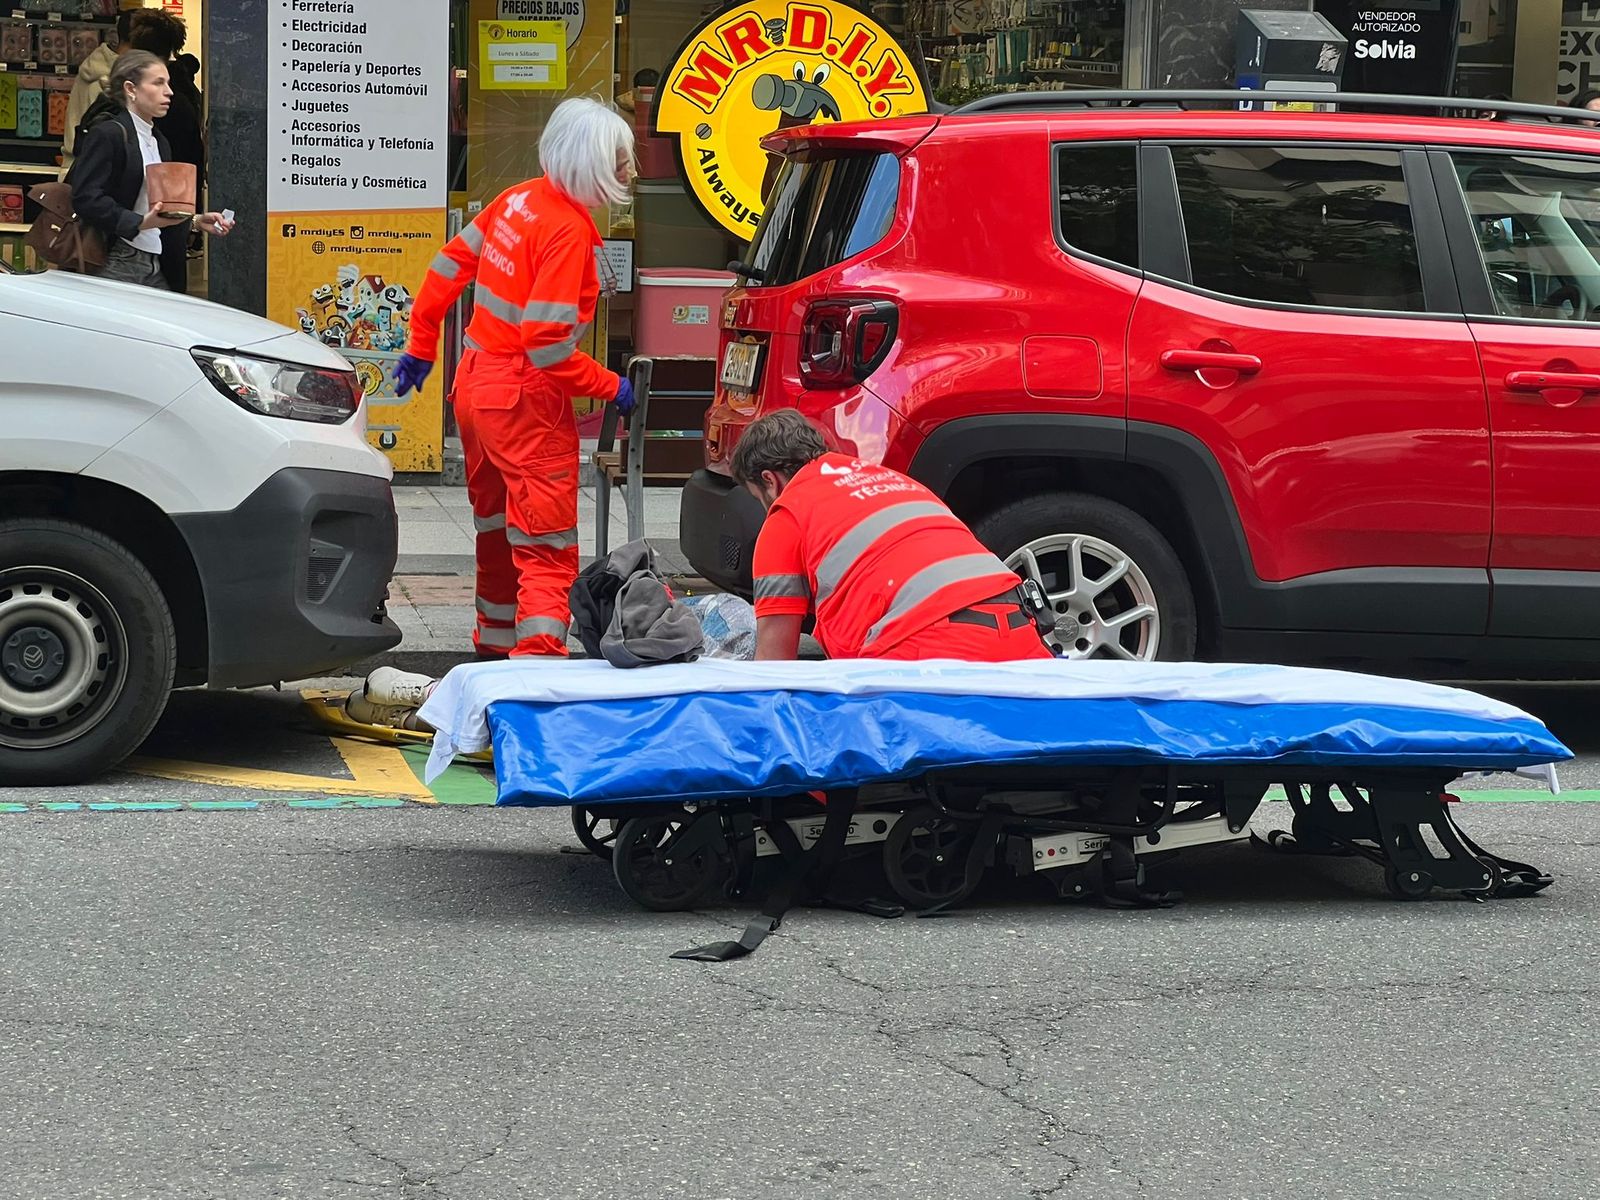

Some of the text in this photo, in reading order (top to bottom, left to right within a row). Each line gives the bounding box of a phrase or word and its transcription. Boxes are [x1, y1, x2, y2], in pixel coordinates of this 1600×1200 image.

[292, 0, 354, 13] Ferretería
[502, 0, 580, 15] PRECIOS BAJOS
[1357, 11, 1416, 21] VENDEDOR
[292, 19, 367, 34] Electricidad
[506, 28, 538, 38] Horario
[1351, 22, 1421, 32] AUTORIZADO
[292, 39, 363, 54] Decoración
[1354, 39, 1416, 59] Solvia
[292, 59, 422, 77] Papelería y Deportes
[291, 79, 428, 96] Accesorios Automóvil
[291, 100, 349, 114] Juguetes
[291, 119, 361, 133] Accesorios
[291, 134, 434, 150] Informática y Telefonía
[291, 154, 341, 168] Regalos
[291, 173, 427, 189] Bisutería y Cosmética
[697, 148, 762, 227] Always
[300, 228, 345, 237] mrdiyES
[368, 230, 432, 239] mrdiy.spain
[330, 246, 402, 254] mrdiy.com/es
